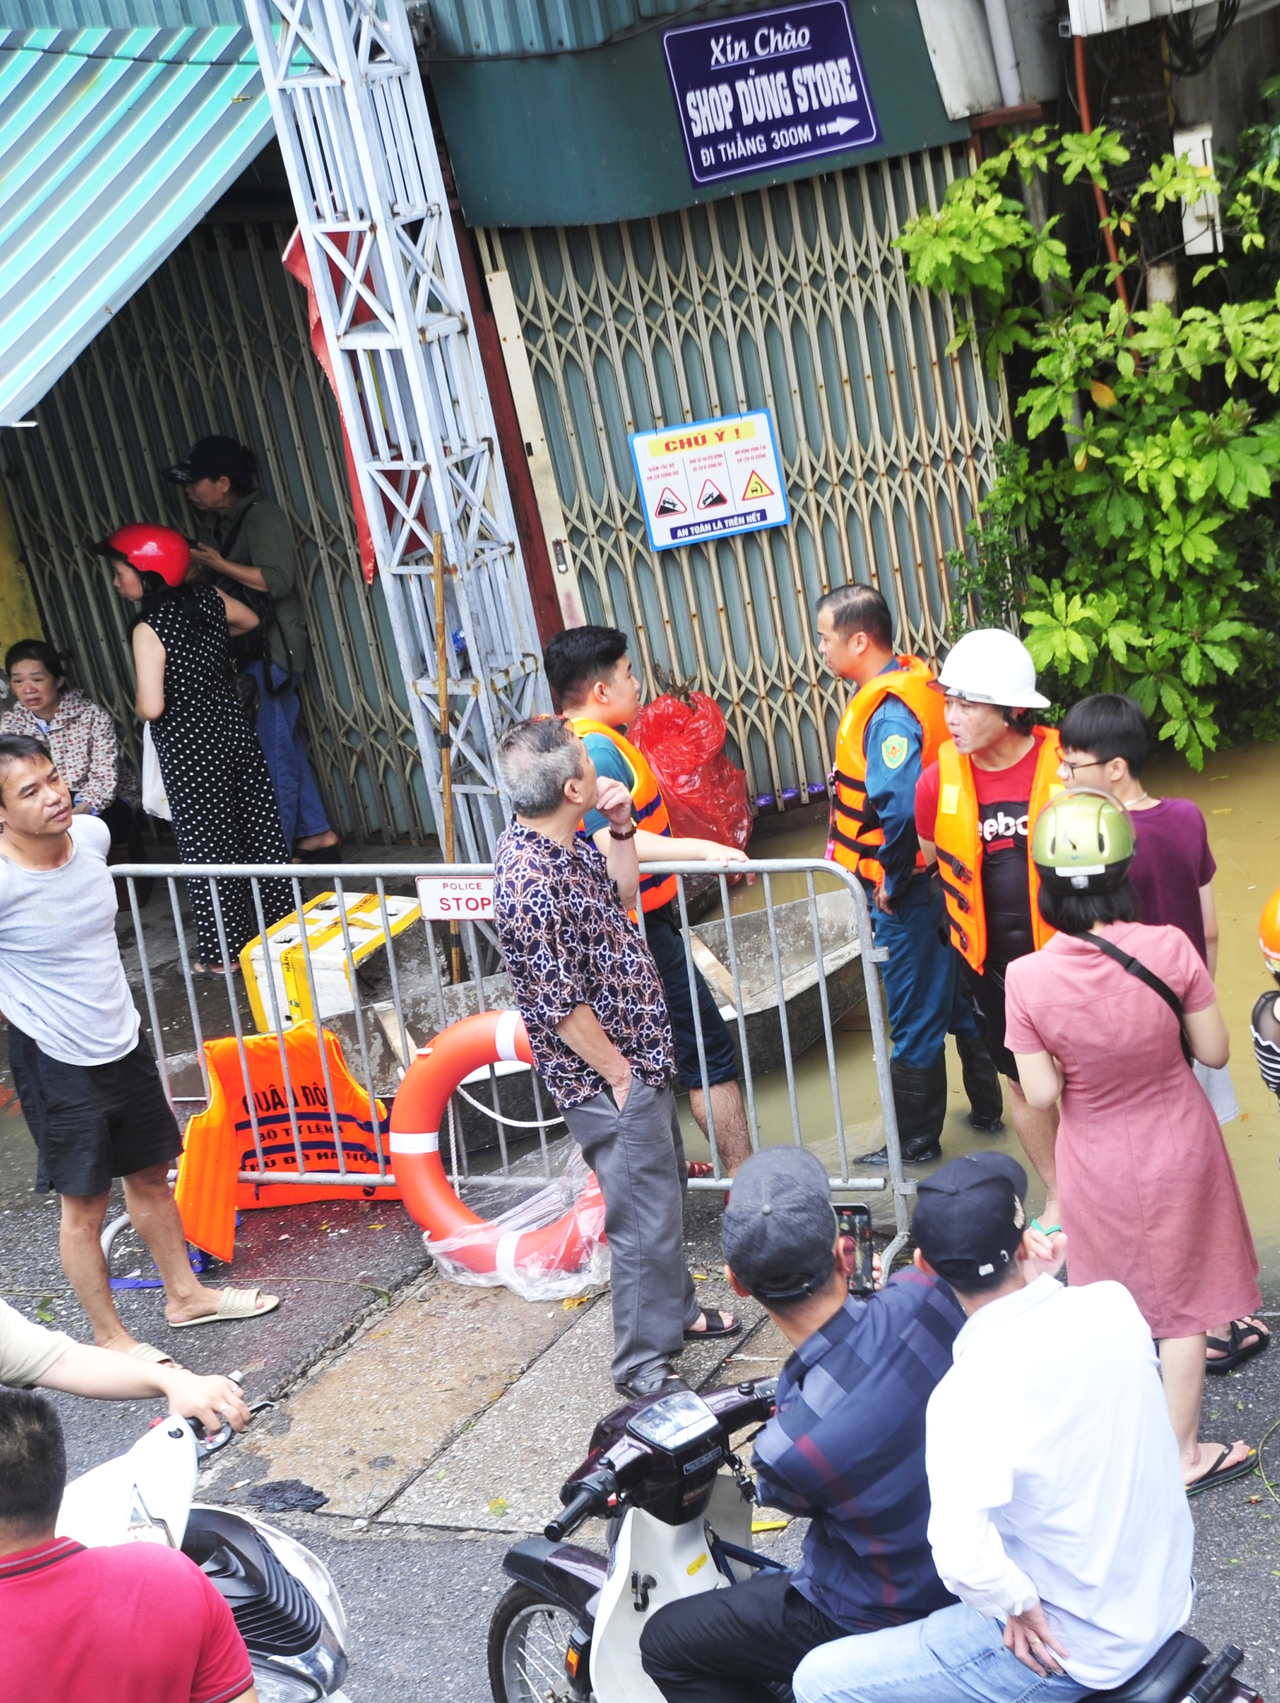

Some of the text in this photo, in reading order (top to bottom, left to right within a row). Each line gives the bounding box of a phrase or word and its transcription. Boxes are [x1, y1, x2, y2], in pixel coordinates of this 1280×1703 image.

[710, 22, 811, 66] Xin Chào
[686, 83, 734, 138] SHOP
[792, 56, 858, 113] STORE
[700, 145, 715, 167] ĐI
[771, 124, 812, 150] 300M
[664, 433, 707, 453] CHÚ
[714, 429, 726, 443] Ý
[676, 527, 689, 539] AN
[690, 522, 711, 535] TOÀN
[712, 519, 724, 531] LÀ
[724, 516, 746, 529] TRÊN
[442, 882, 483, 890] POLICE
[439, 897, 492, 911] STOP
[301, 1082, 329, 1111] ĐỘ
